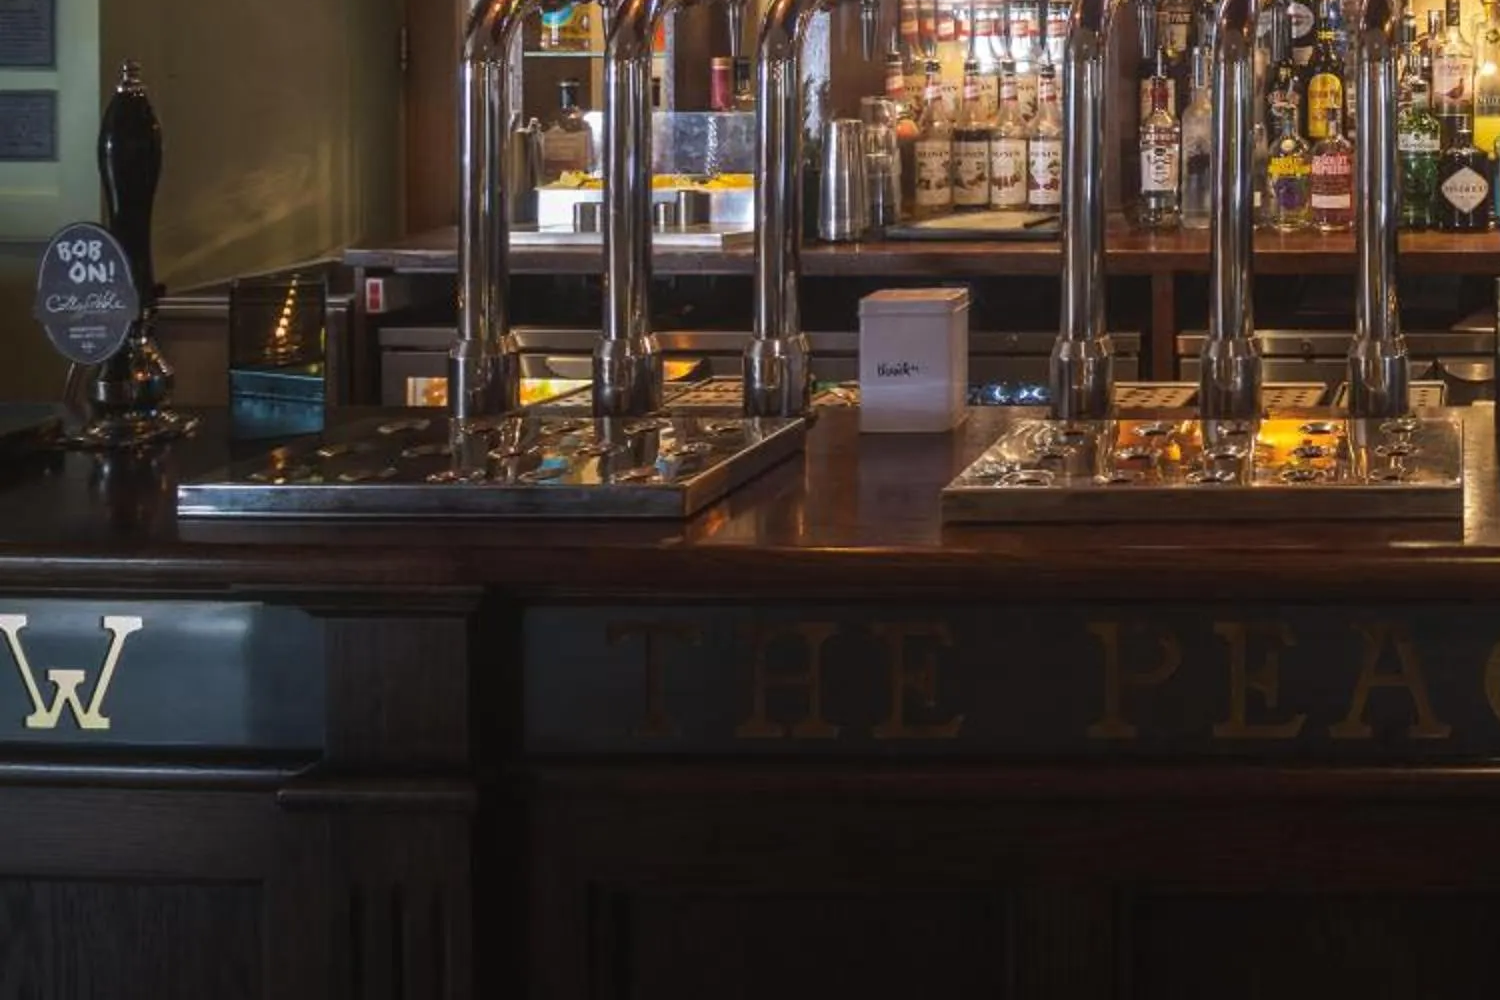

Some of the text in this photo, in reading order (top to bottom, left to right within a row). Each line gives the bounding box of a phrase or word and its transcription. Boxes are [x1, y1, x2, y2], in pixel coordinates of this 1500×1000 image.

[56, 239, 103, 262] BOB
[69, 261, 116, 284] ON!
[0, 614, 143, 729] W
[606, 619, 965, 739] THE
